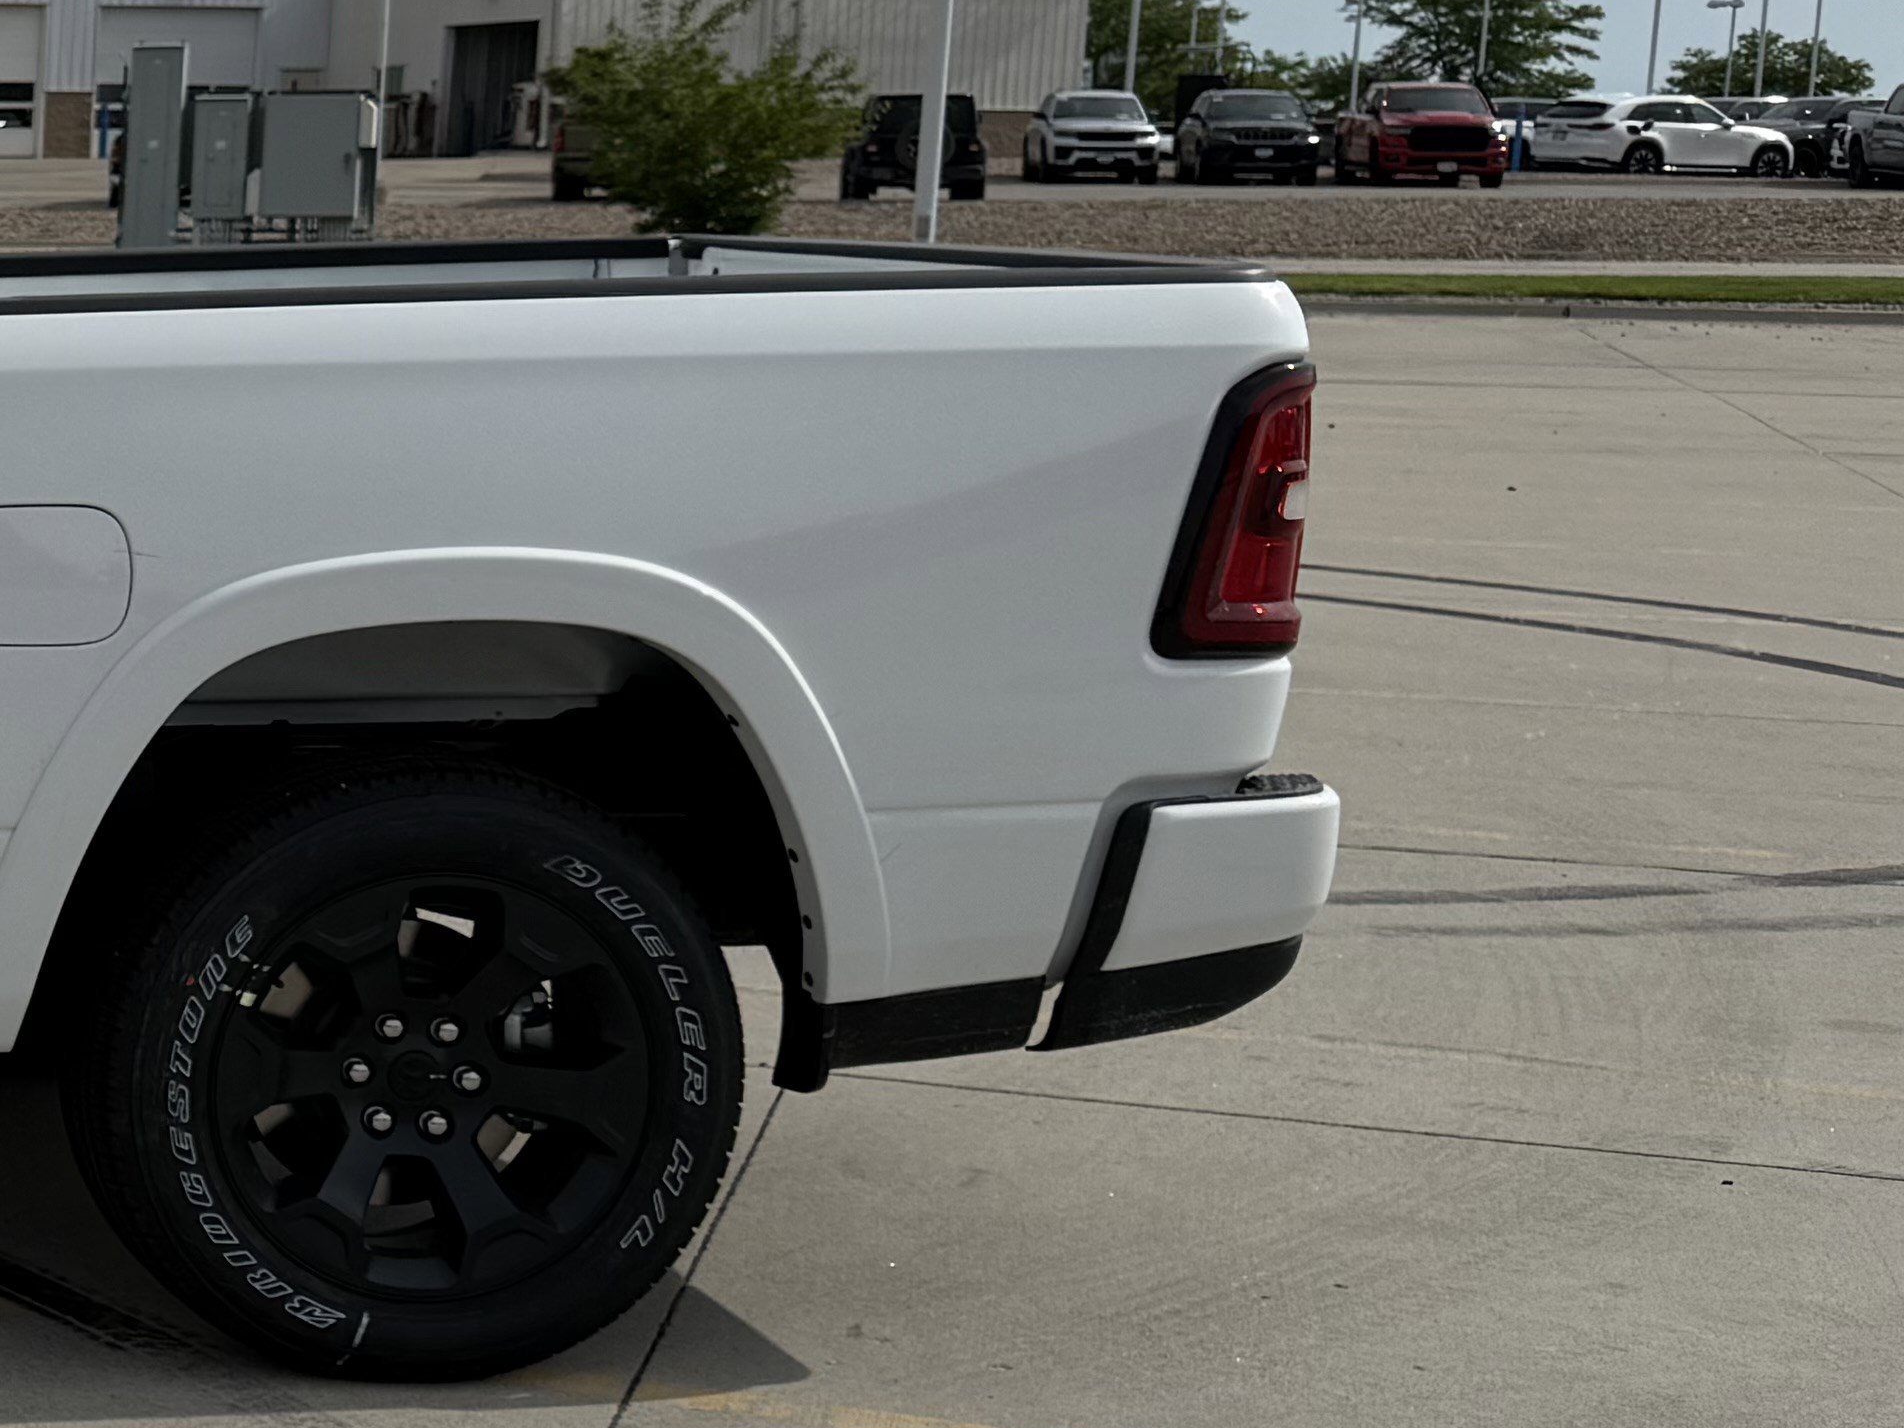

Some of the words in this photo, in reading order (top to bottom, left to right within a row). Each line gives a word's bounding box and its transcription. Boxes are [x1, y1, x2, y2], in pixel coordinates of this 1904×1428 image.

[543, 854, 708, 1106] DUELER
[168, 914, 348, 1330] BRIDGESTONE
[620, 1138, 694, 1252] H/L
